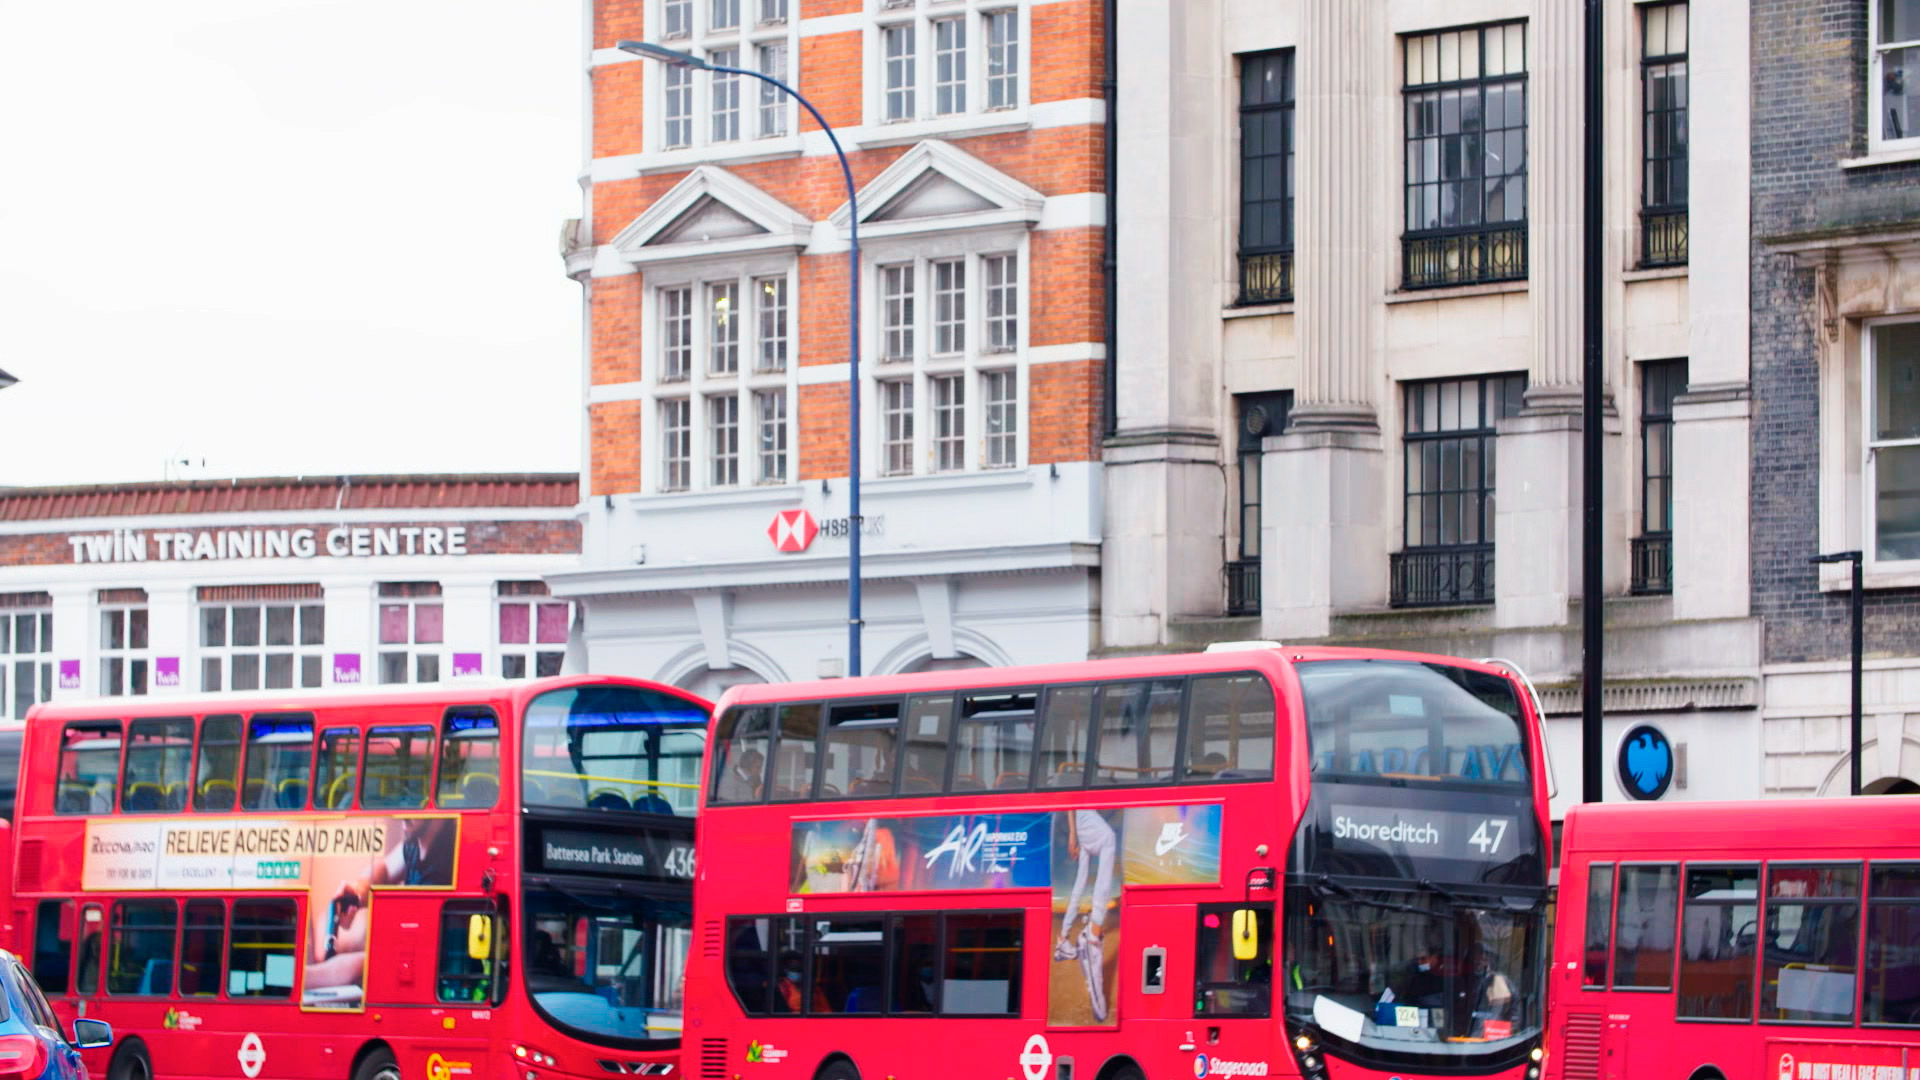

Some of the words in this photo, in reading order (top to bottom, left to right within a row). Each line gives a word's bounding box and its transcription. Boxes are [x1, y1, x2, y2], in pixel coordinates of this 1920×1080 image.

[819, 516, 864, 538] HSB
[154, 529, 316, 558] TRAINING
[326, 526, 467, 556] CENTRE
[165, 830, 231, 854] RELIEVE
[234, 828, 290, 854] ACHES
[293, 828, 329, 853] AND
[333, 827, 384, 853] PAINS
[1334, 815, 1439, 844] Shoreditch
[1467, 819, 1508, 854] 47
[181, 868, 217, 878] EXCELLENT
[546, 842, 590, 862] Battersea
[591, 846, 612, 864] Park
[612, 847, 645, 867] Station
[664, 847, 696, 877] 436
[1209, 1057, 1268, 1080] Stagecoach
